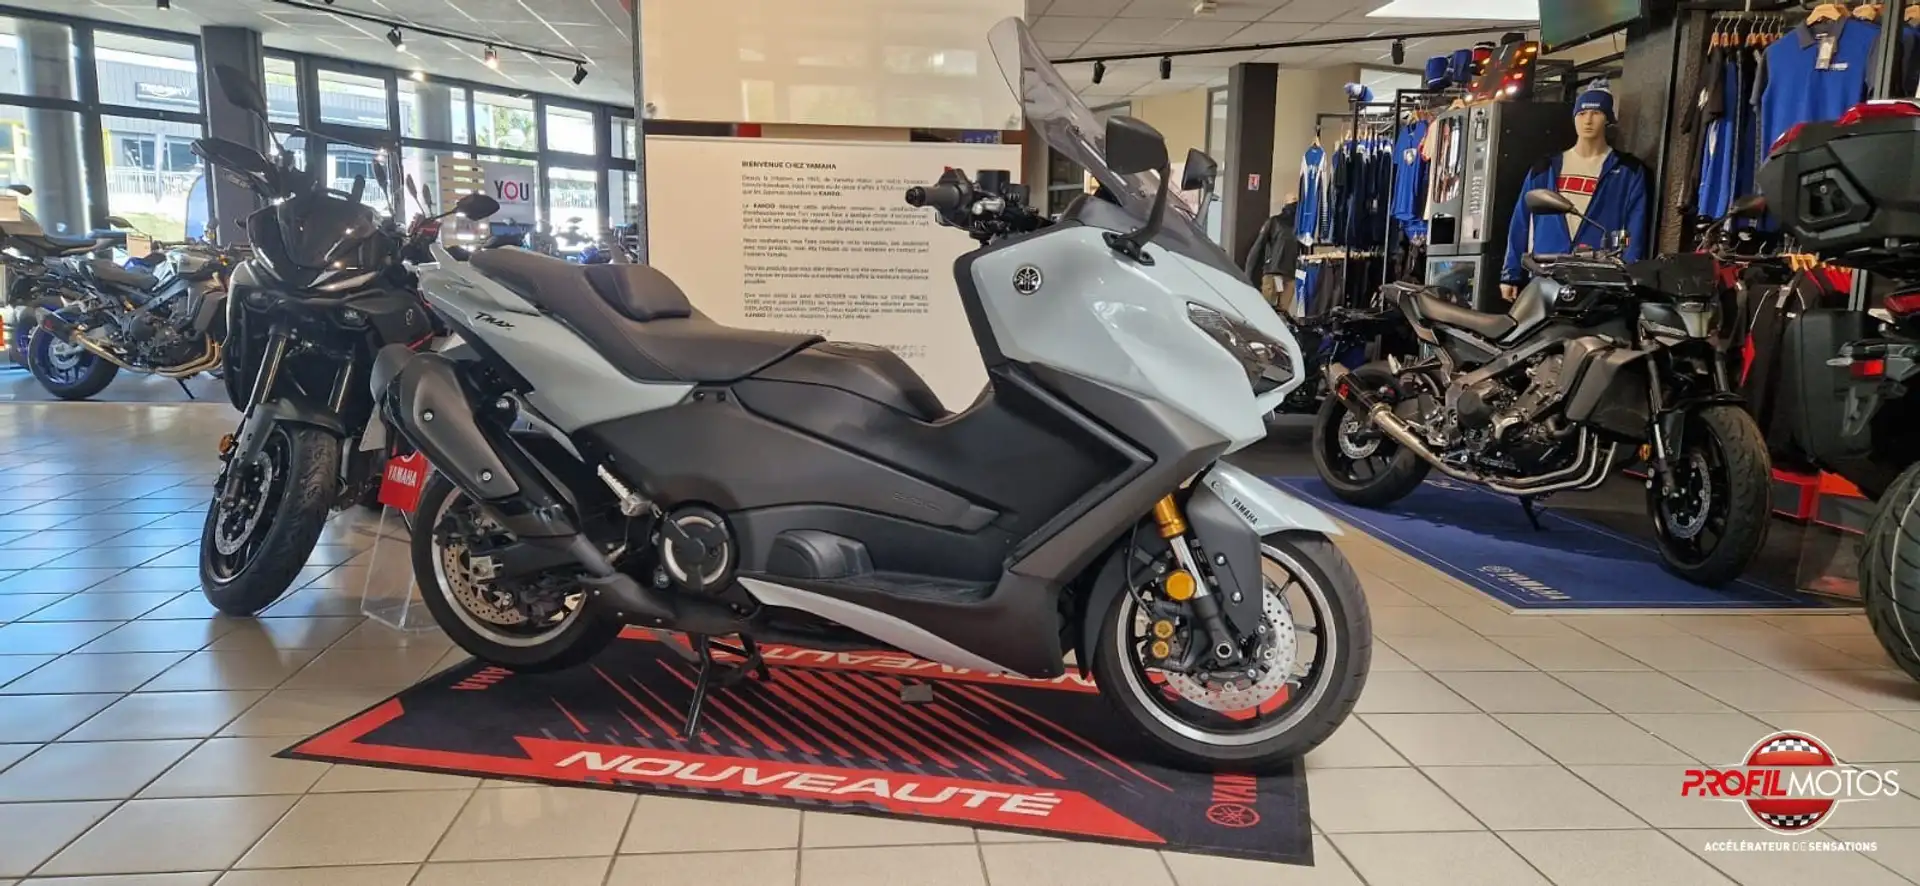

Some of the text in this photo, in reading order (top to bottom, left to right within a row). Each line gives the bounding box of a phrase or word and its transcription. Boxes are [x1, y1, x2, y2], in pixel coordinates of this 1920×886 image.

[741, 160, 783, 169] BIENVENUE
[494, 180, 529, 201] YOU
[387, 464, 418, 487] YAMAHA
[1231, 496, 1260, 525] YAMAHA
[1497, 572, 1572, 600] YAMAHA
[554, 750, 1062, 817] NOUVEAUTÉ
